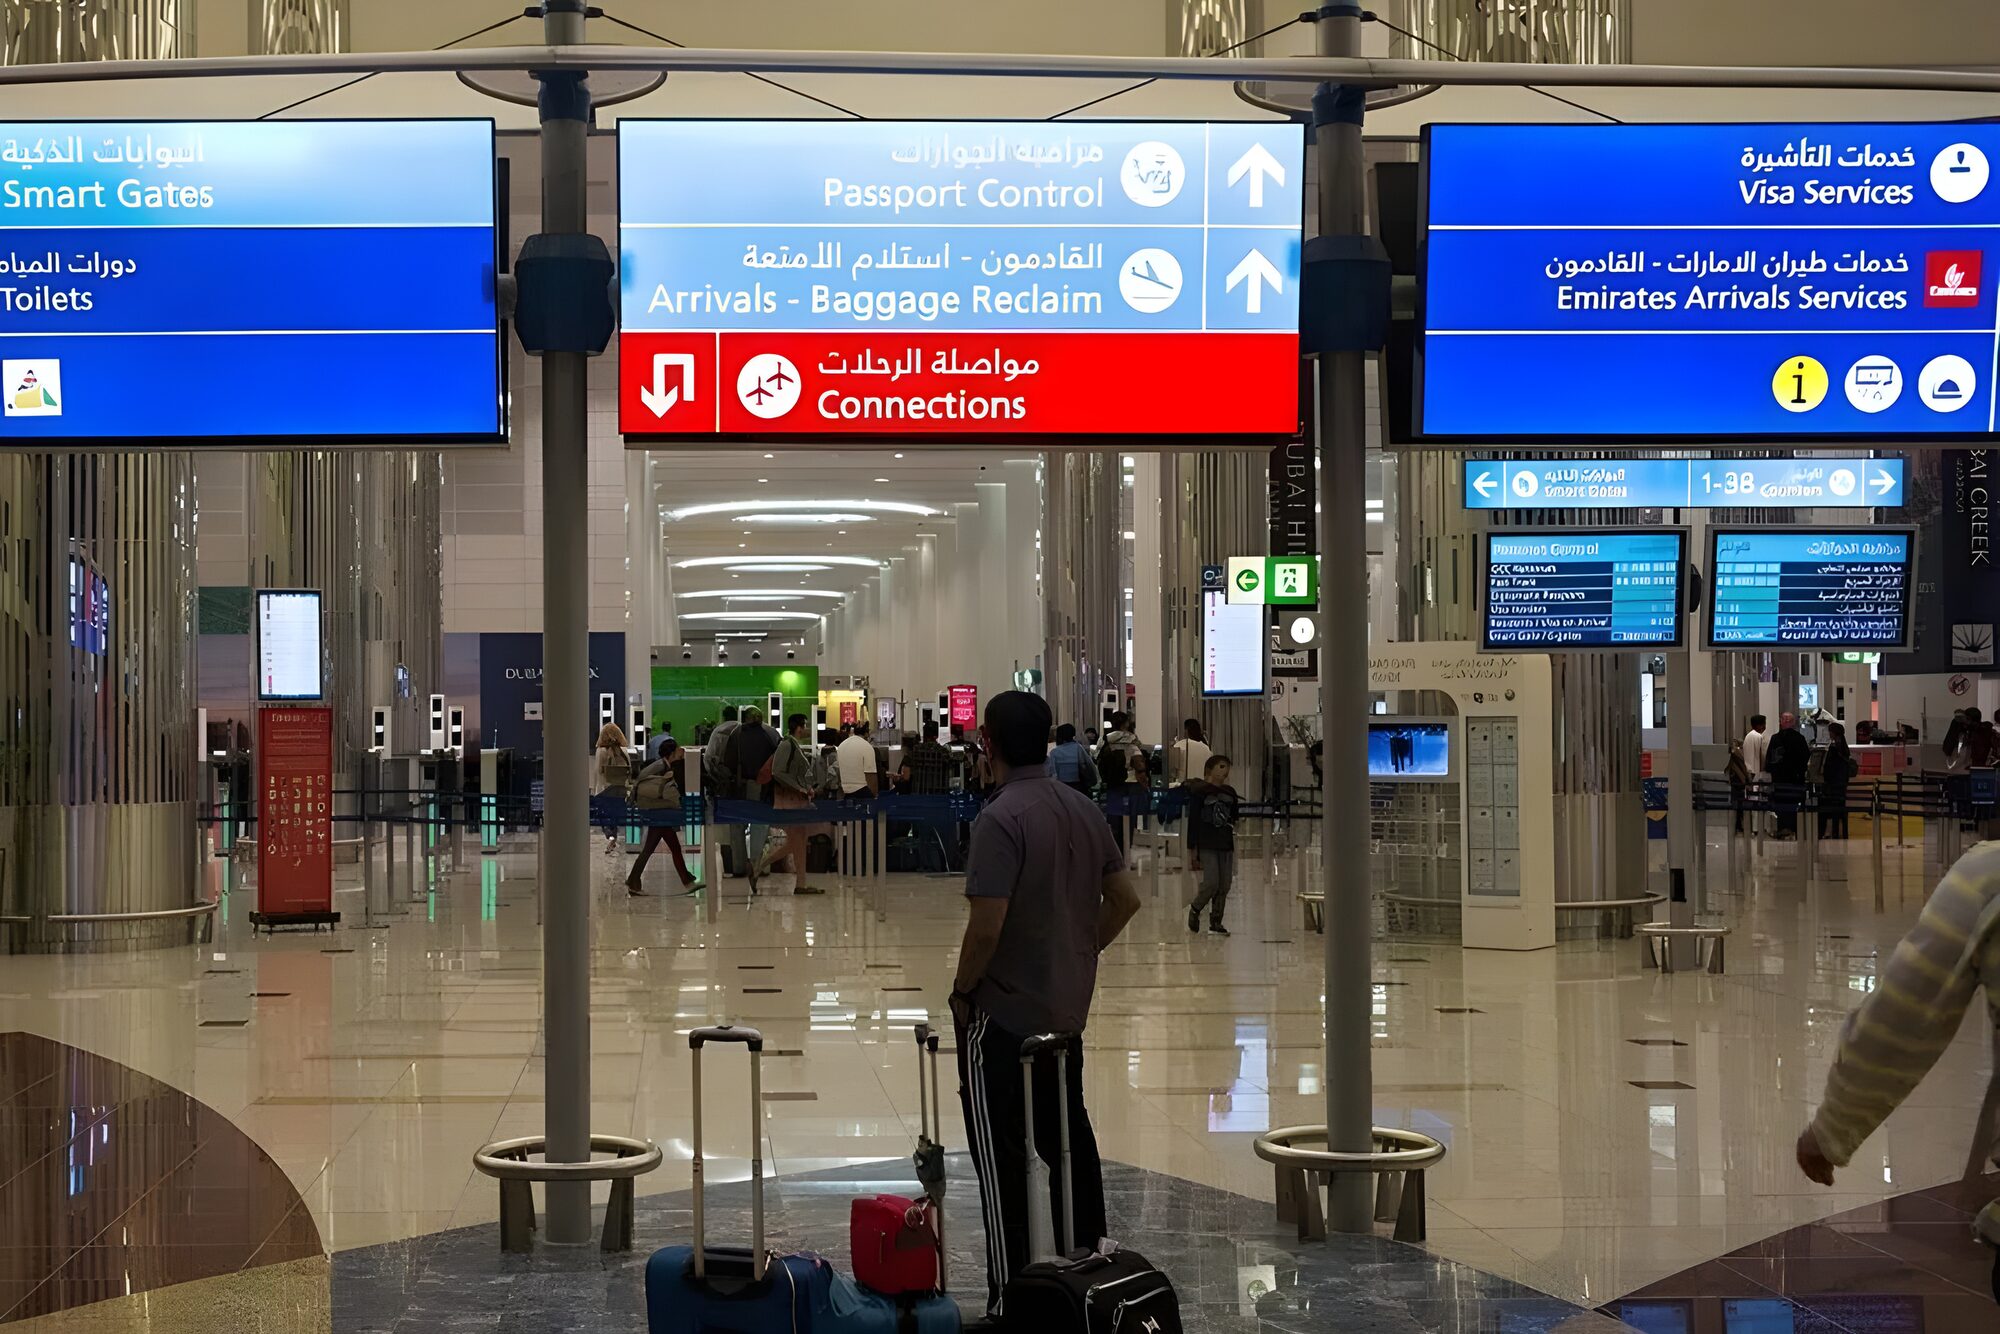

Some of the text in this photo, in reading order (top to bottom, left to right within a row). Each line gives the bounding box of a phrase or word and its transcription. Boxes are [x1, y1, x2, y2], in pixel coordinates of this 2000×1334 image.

[1740, 136, 1916, 173] خدمات التأشيرة
[3, 178, 214, 208] Smart Gates
[824, 176, 1103, 215] Passport Control
[1739, 178, 1913, 205] Visa Services
[67, 251, 137, 278] دورات
[851, 241, 950, 281] استلام
[981, 242, 1103, 276] القادمون
[1545, 250, 1645, 278] القادمون
[1762, 249, 1828, 278] طيران
[1833, 249, 1909, 273] خدمات
[0, 285, 94, 312] Toilets
[647, 281, 777, 314] Arrivals
[811, 284, 961, 321] Baggage
[972, 283, 1103, 314] Reclaim
[1557, 285, 1677, 310] Emirates
[1684, 283, 1791, 310] Arrivals
[1798, 283, 1908, 310] Services
[818, 347, 1040, 382] مواصلة الرحلات
[818, 389, 1027, 420] Connections
[1970, 487, 1991, 566] CREEK
